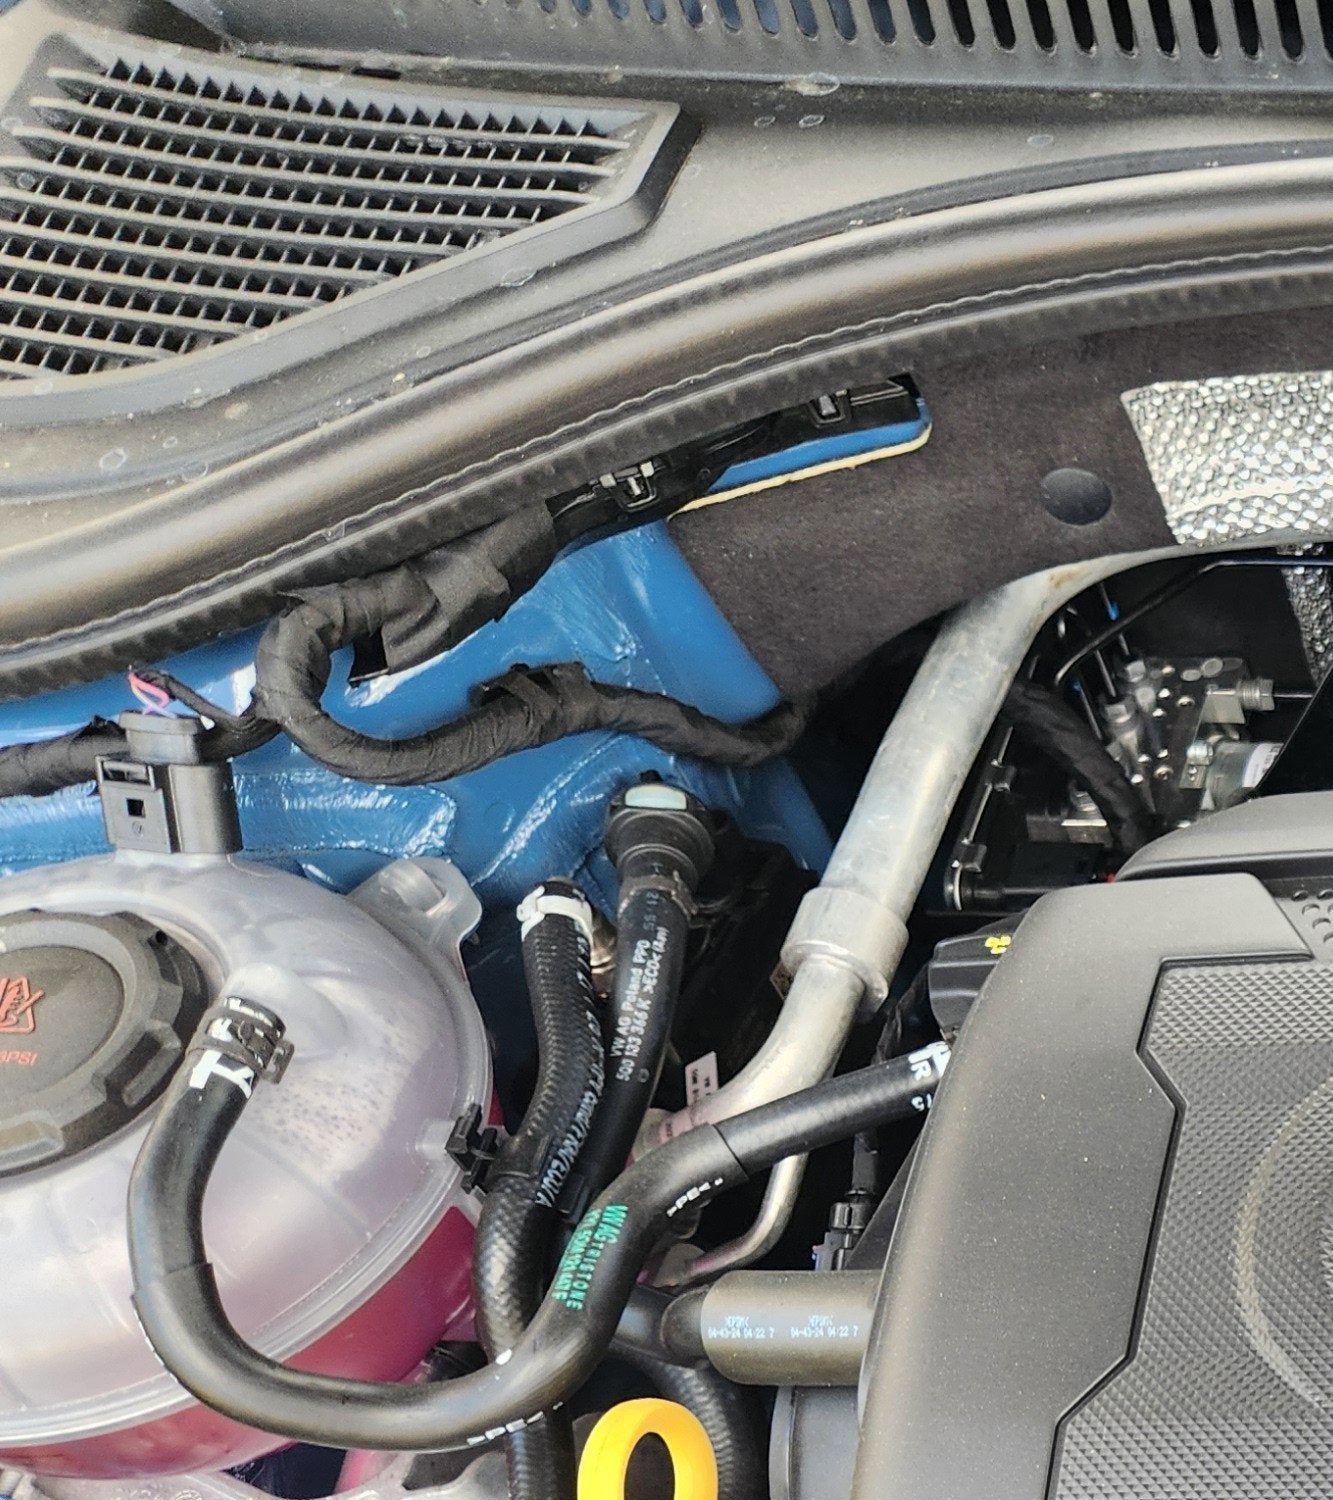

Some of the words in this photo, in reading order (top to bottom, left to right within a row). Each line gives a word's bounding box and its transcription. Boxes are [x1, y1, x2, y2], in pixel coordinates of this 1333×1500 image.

[620, 967, 644, 1013] Poland
[615, 1015, 632, 1037] AG
[610, 1036, 627, 1058] VW
